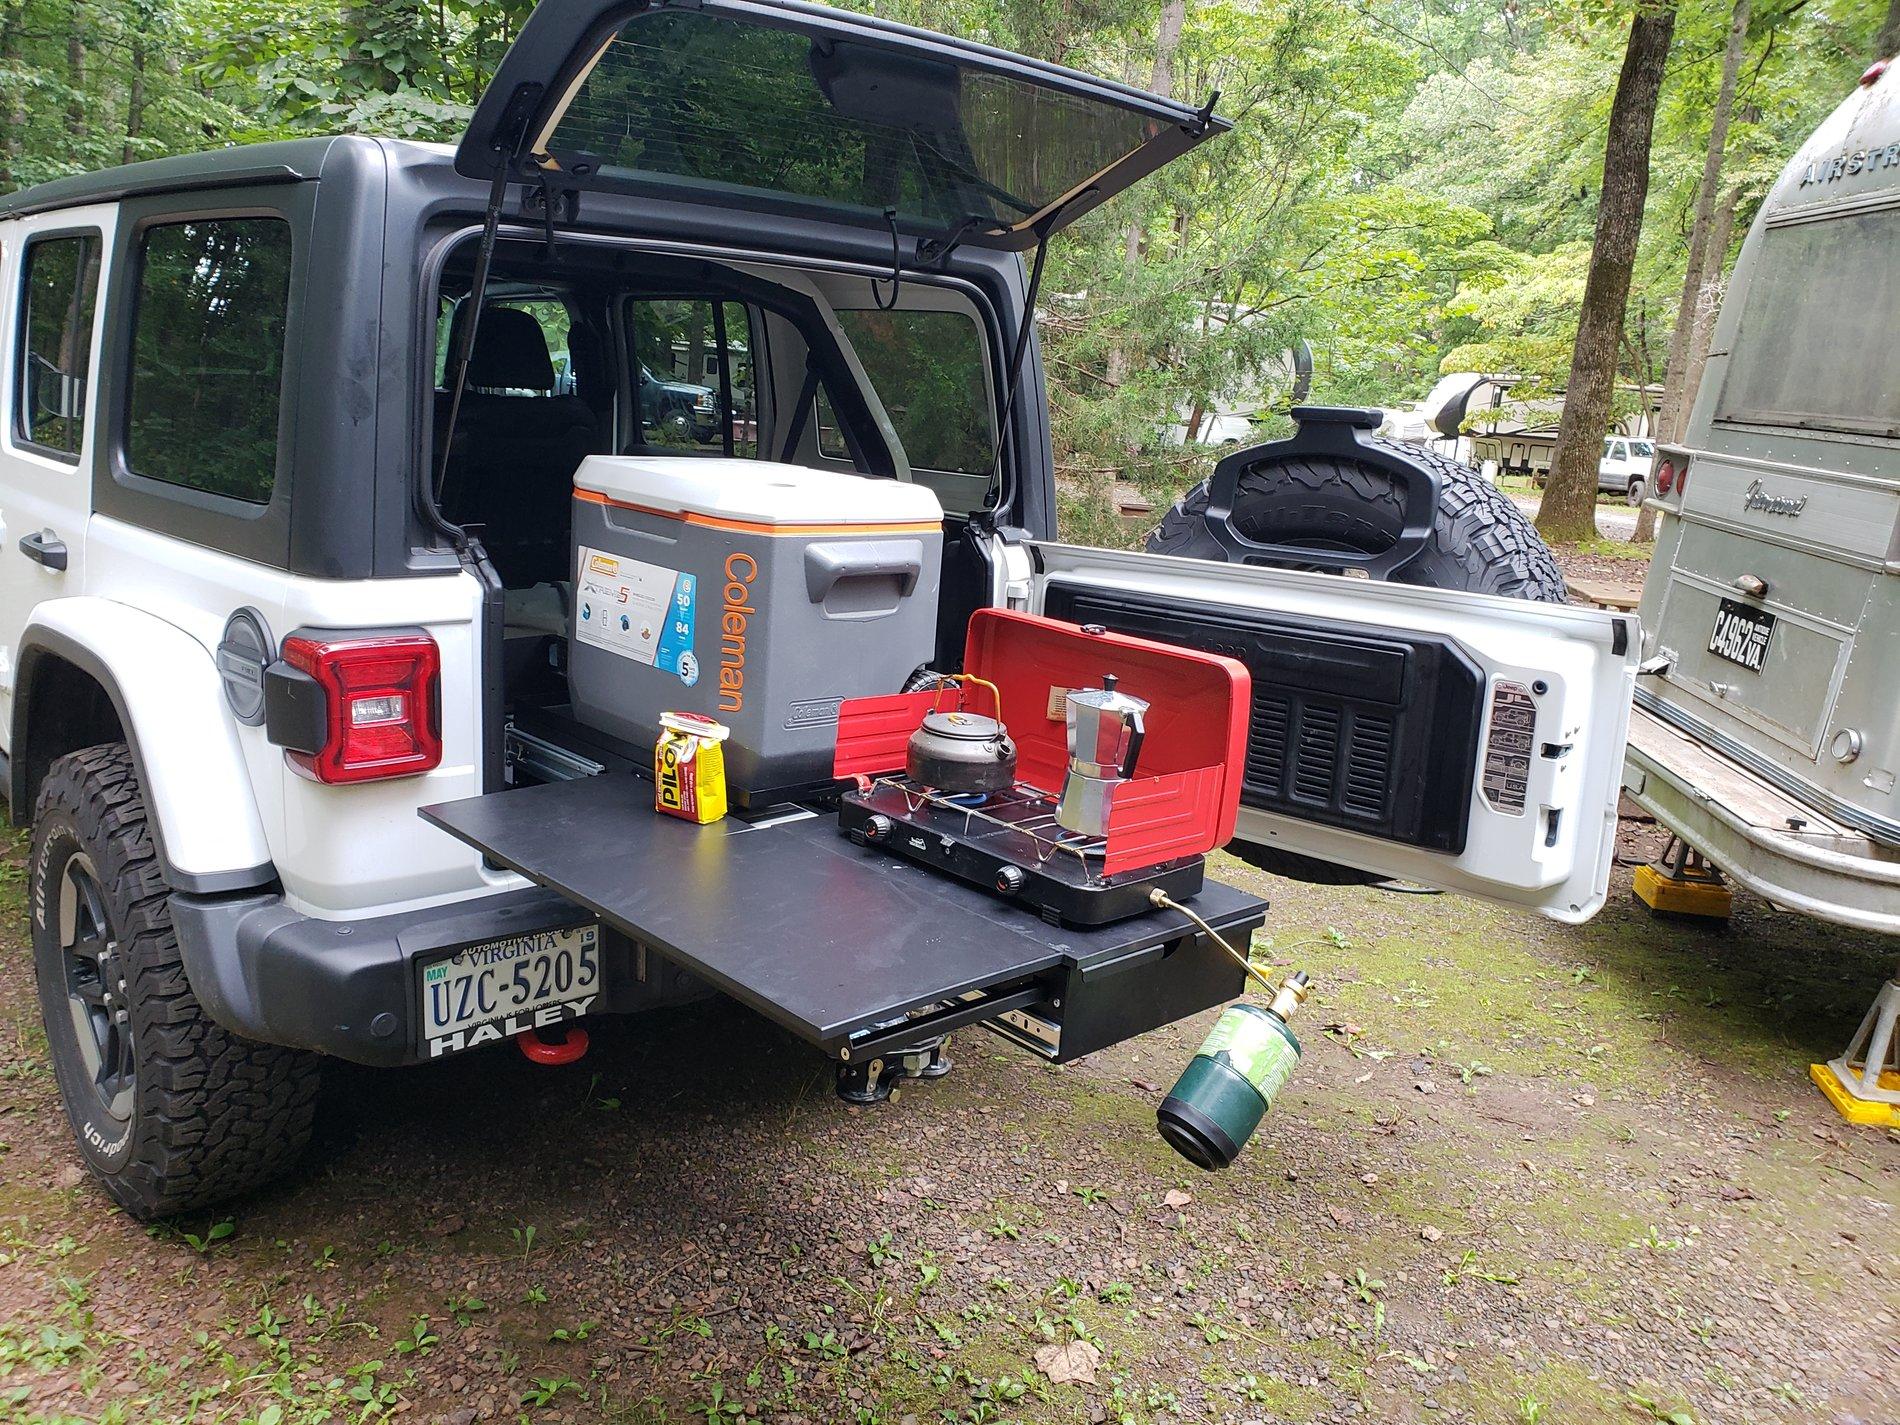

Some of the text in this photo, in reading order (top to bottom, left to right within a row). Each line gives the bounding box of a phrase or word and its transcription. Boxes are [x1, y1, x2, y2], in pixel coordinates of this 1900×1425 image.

[677, 593, 690, 607] 50
[675, 622, 689, 635] 84
[718, 552, 758, 713] Coleman
[1709, 610, 1754, 663] C4962
[681, 662, 689, 676] 5
[580, 931, 594, 943] 19
[466, 934, 558, 967] VIRGINIA
[426, 966, 448, 981] MAY
[431, 943, 597, 1027] UZC-5205
[430, 995, 597, 1058] HALEY
